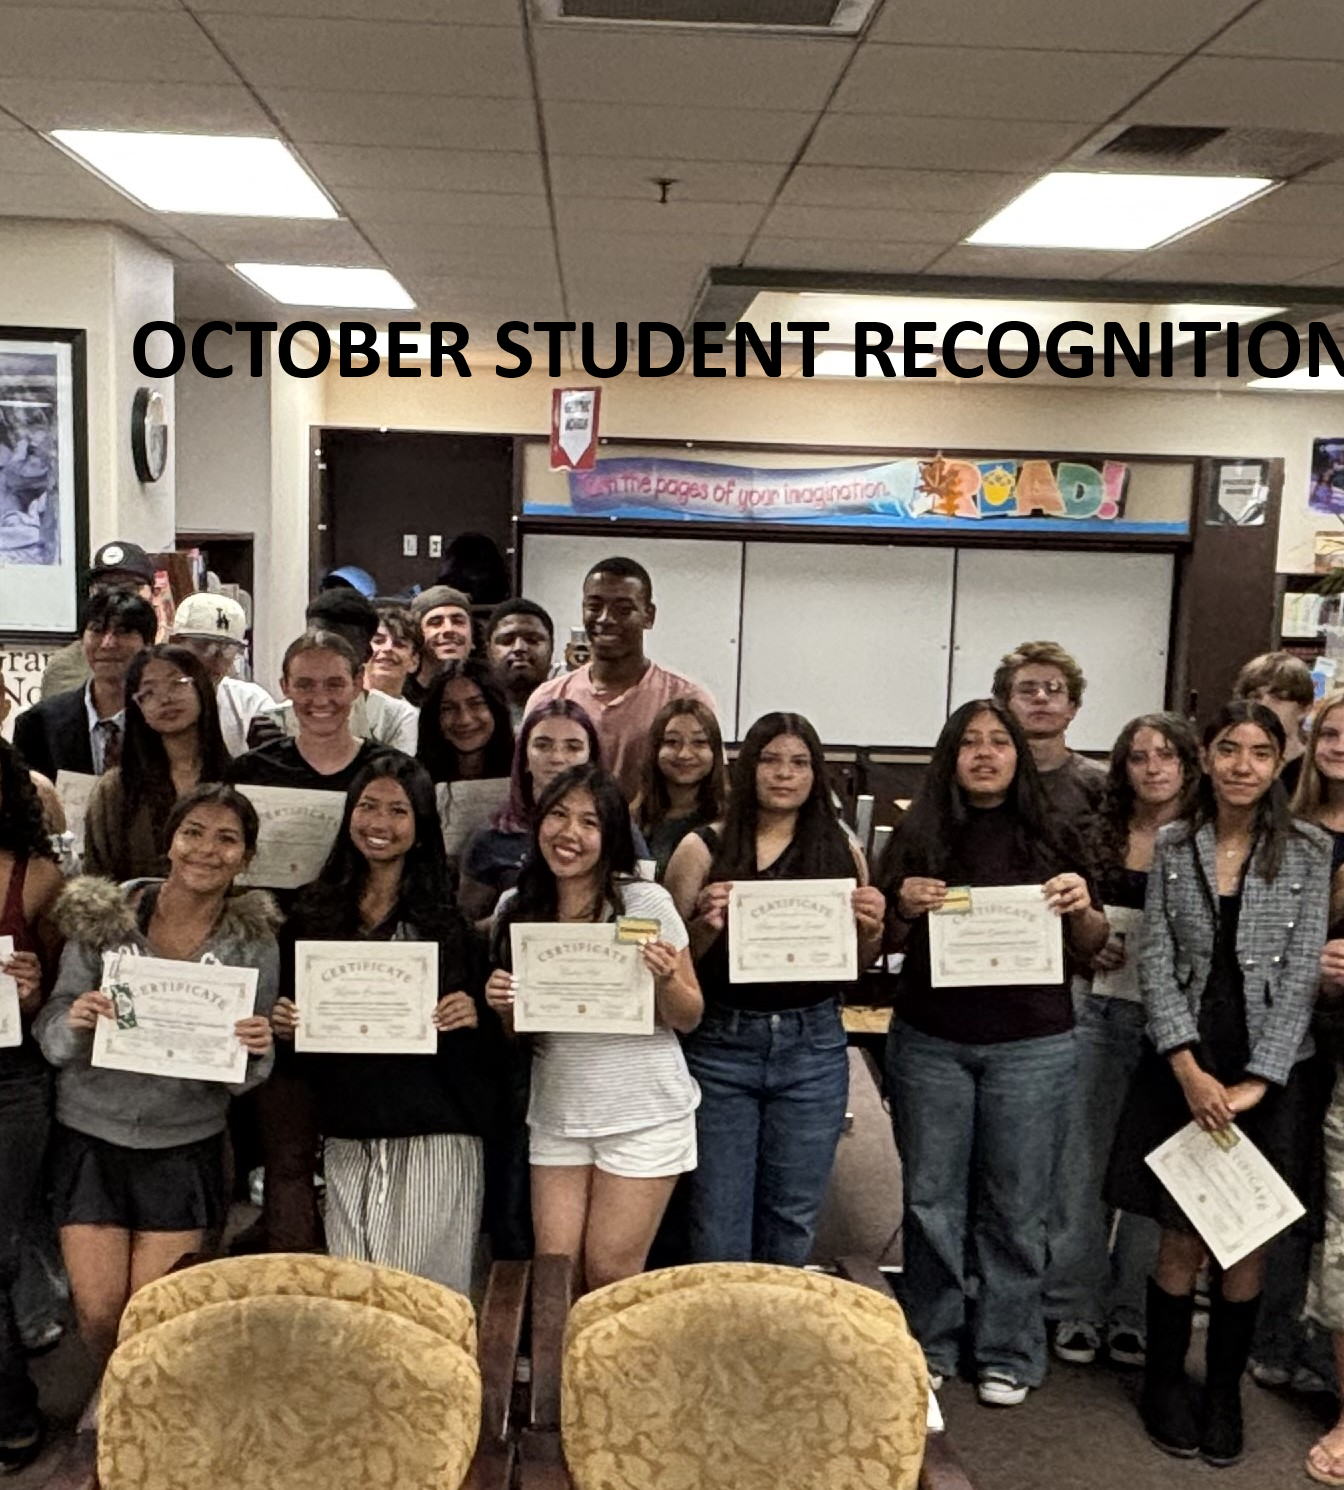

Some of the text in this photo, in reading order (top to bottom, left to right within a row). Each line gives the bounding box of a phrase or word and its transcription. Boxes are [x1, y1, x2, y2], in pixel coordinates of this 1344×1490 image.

[932, 458, 1129, 520] RAD!
[750, 898, 834, 919] CERTIFICATE
[952, 904, 1037, 925] CTIFICATE
[537, 942, 629, 964] CERTIFICATE
[320, 961, 413, 984] CERTIFICATE
